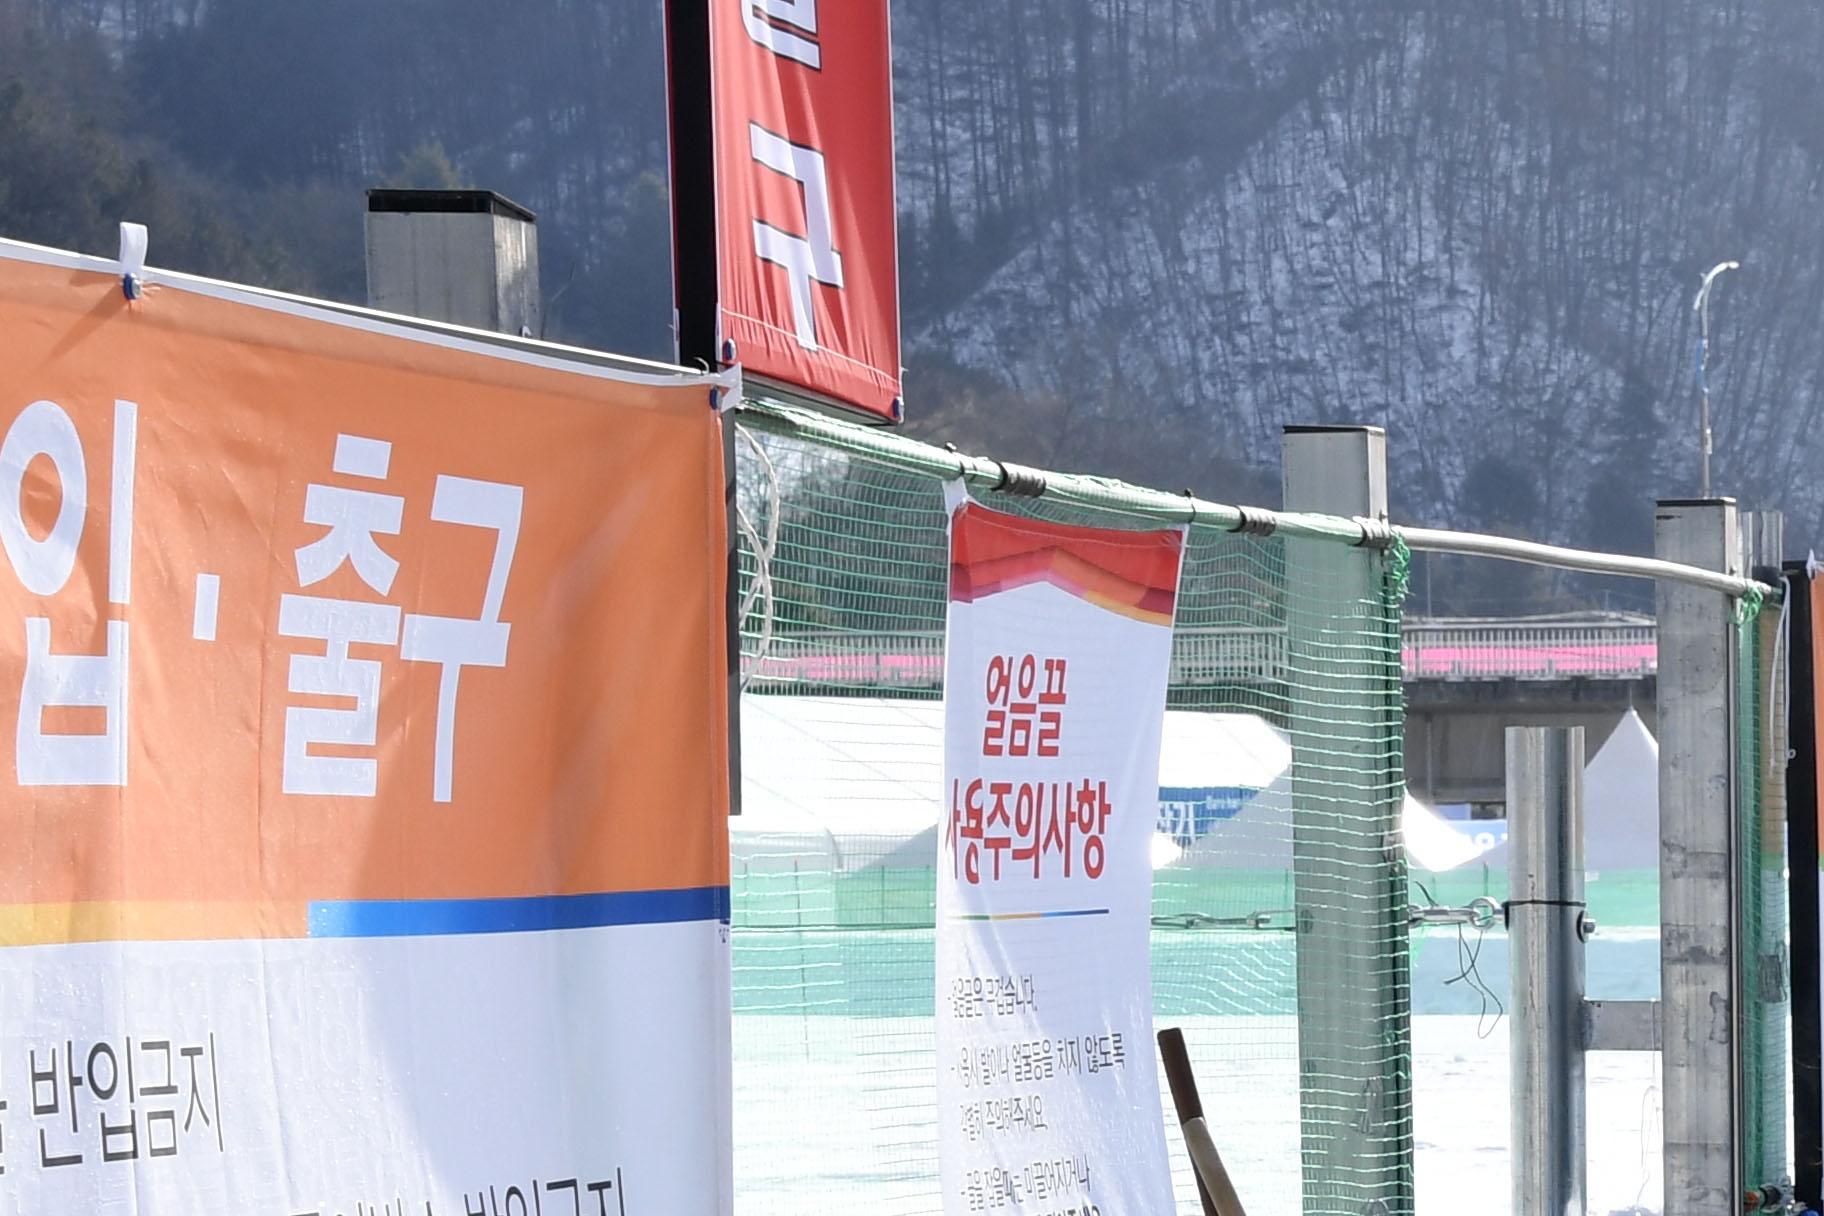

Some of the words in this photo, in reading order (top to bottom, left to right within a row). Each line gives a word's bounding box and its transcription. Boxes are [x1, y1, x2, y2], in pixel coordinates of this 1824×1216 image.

[982, 653, 1067, 758] 얼음끌
[30, 1033, 225, 1169] 반입금지
[1085, 1033, 1126, 1074] 않도록
